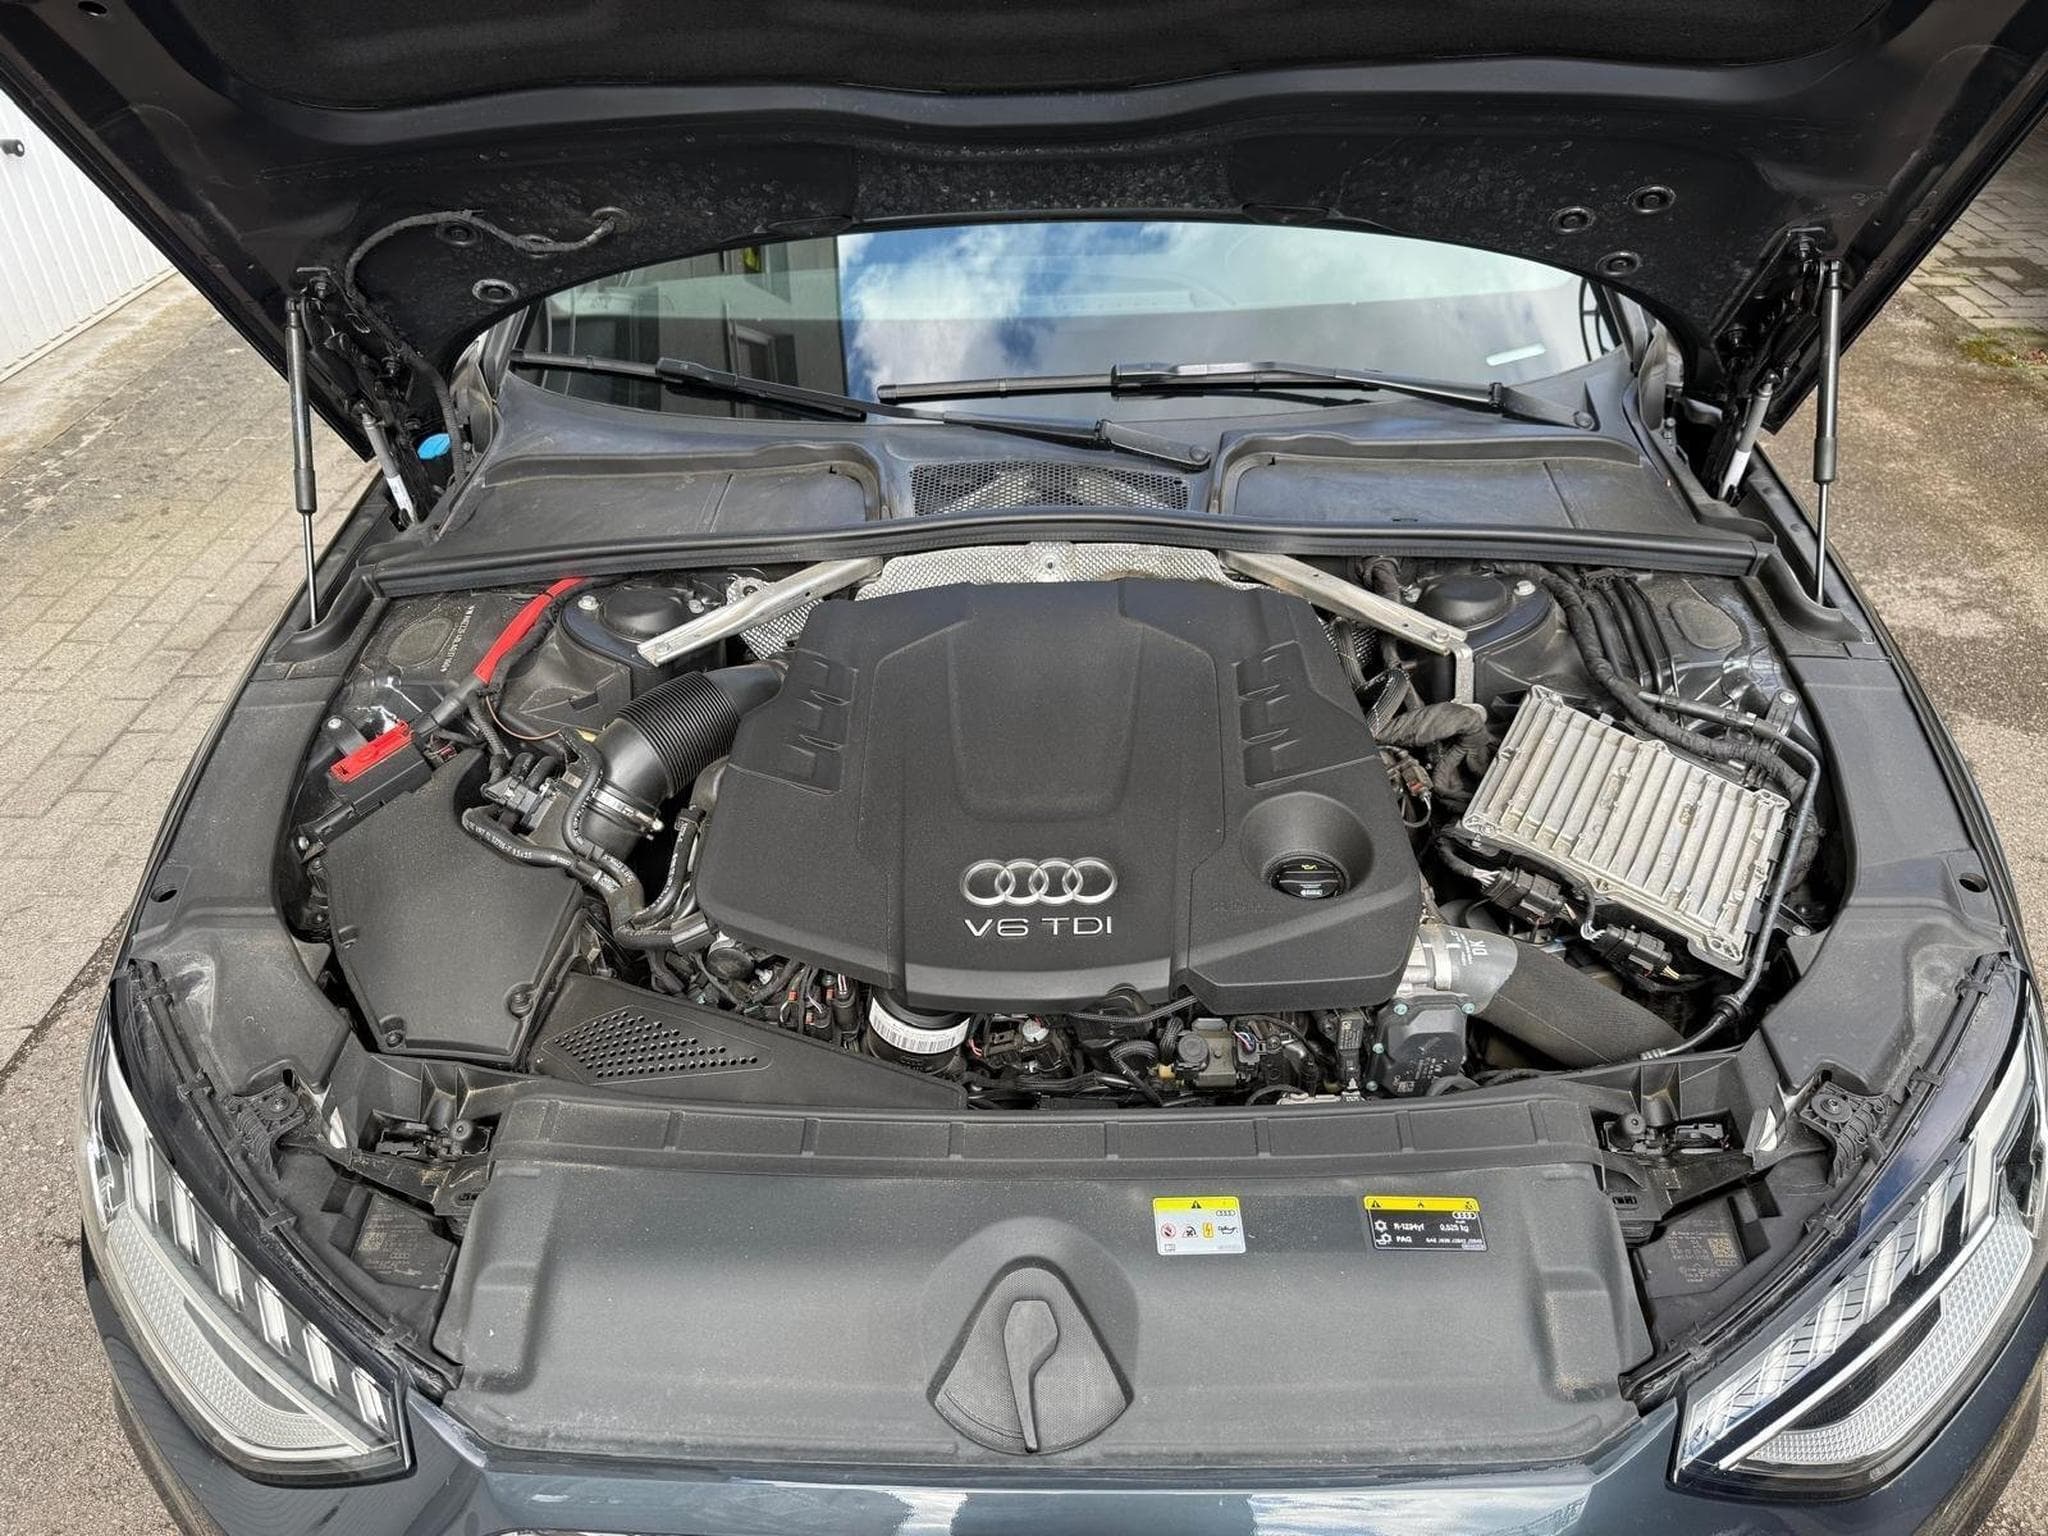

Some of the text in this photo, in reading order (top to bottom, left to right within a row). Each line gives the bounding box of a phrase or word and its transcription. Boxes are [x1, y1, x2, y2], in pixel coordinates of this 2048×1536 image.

[964, 915, 1113, 937] V6 TDI
[1469, 940, 1489, 956] DK
[1396, 1235, 1413, 1243] PAG
